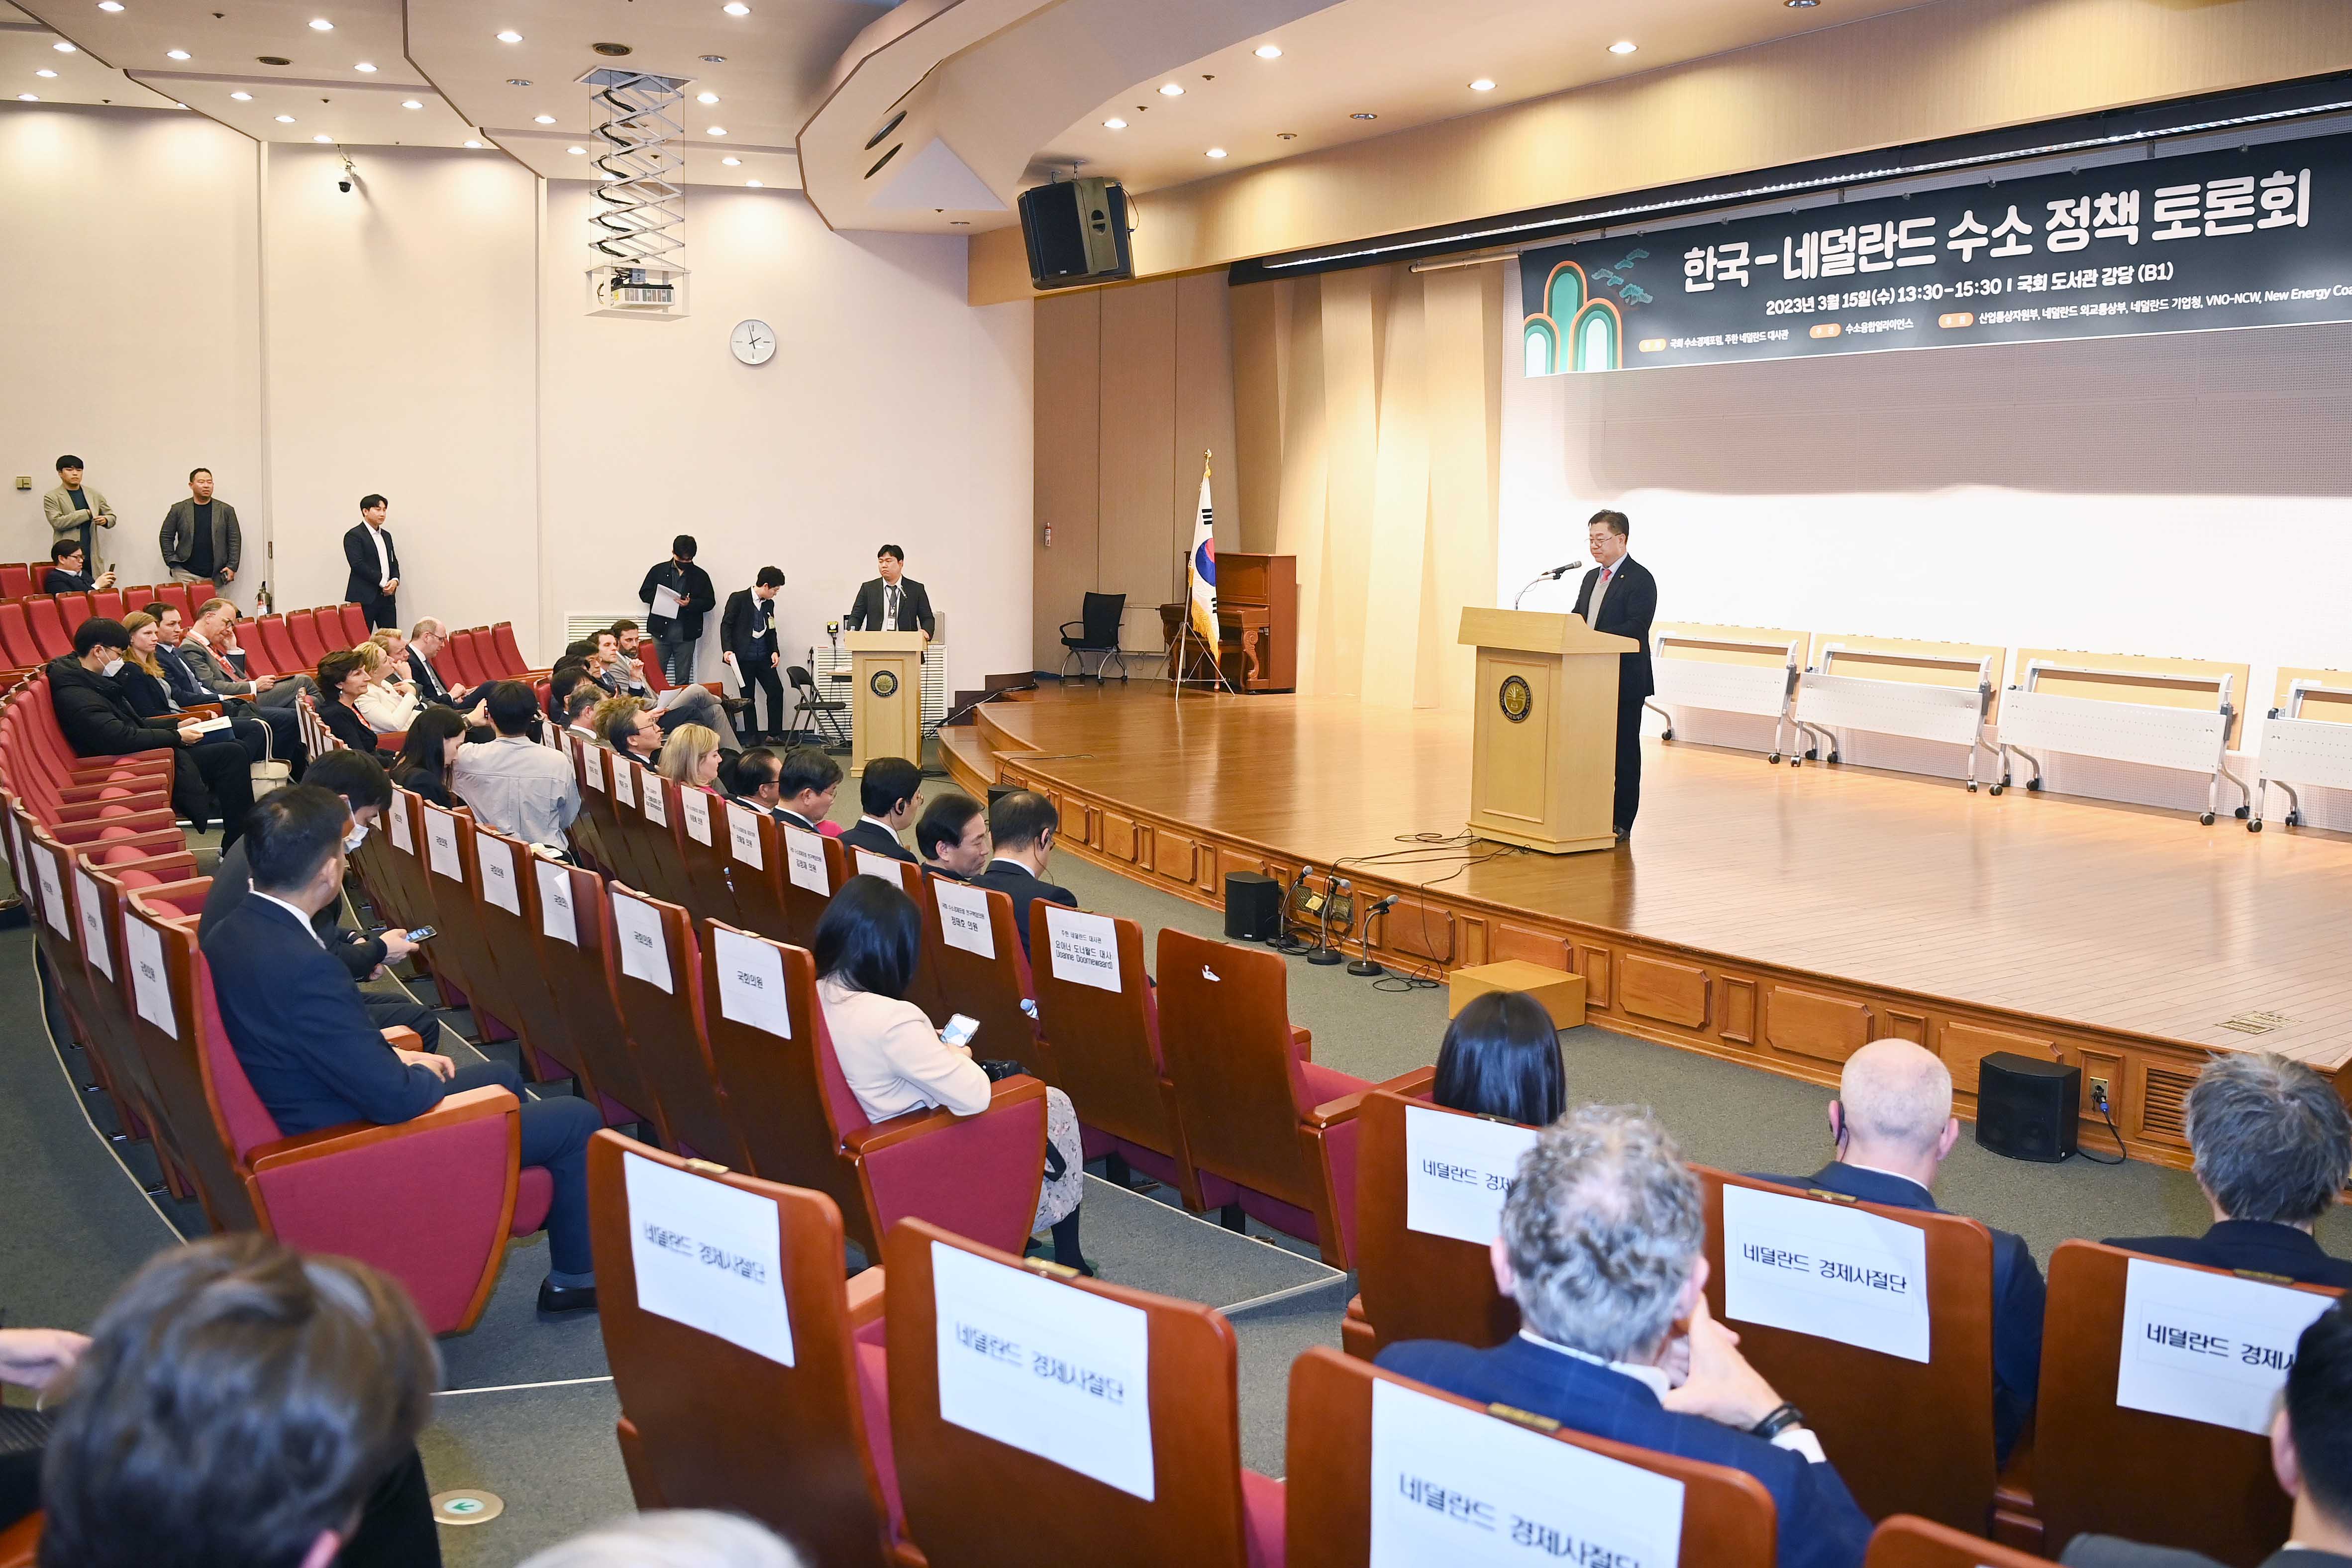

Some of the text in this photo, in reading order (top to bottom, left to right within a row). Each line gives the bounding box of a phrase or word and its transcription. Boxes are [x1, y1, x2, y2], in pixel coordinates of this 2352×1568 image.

[1947, 205, 2033, 263] 수소
[2046, 189, 2140, 253] 정책
[2151, 168, 2311, 241] 토론회
[1766, 296, 1815, 315] 2023년
[1818, 293, 1840, 311] 3월
[1842, 287, 1895, 308] 15일(수)
[1897, 278, 2002, 303] 13:30-15:30
[2017, 273, 2047, 293] 국회
[2050, 269, 2098, 290] 도서관
[2101, 265, 2135, 286] 강당
[2138, 261, 2173, 283] (B1)
[2042, 305, 2078, 318] 네덜란드
[2080, 301, 2129, 316] 외교통상부,
[2130, 299, 2169, 313] 네덜란드
[2206, 291, 2262, 307] VNO-NCW,
[2264, 290, 2289, 302] New
[2291, 288, 2332, 300] Energy
[1725, 333, 1738, 344] 주한
[1739, 330, 1767, 343] 네덜란드
[1767, 329, 1789, 340] 대사관
[809, 863, 817, 873] 의원
[951, 916, 979, 932] 정태호 의원
[1100, 949, 1112, 960] 대사
[737, 970, 763, 989] 국회의원
[1423, 1158, 1478, 1186] 네덜란드
[644, 1221, 766, 1284] 네덜란드 경제사절단
[1743, 1242, 1907, 1295] 네덜란드 경제사절단
[2146, 1322, 2230, 1359] 네덜란드
[955, 1320, 1125, 1404] 네덜란드 경제사절단
[1399, 1473, 1497, 1533] 네덜란드
